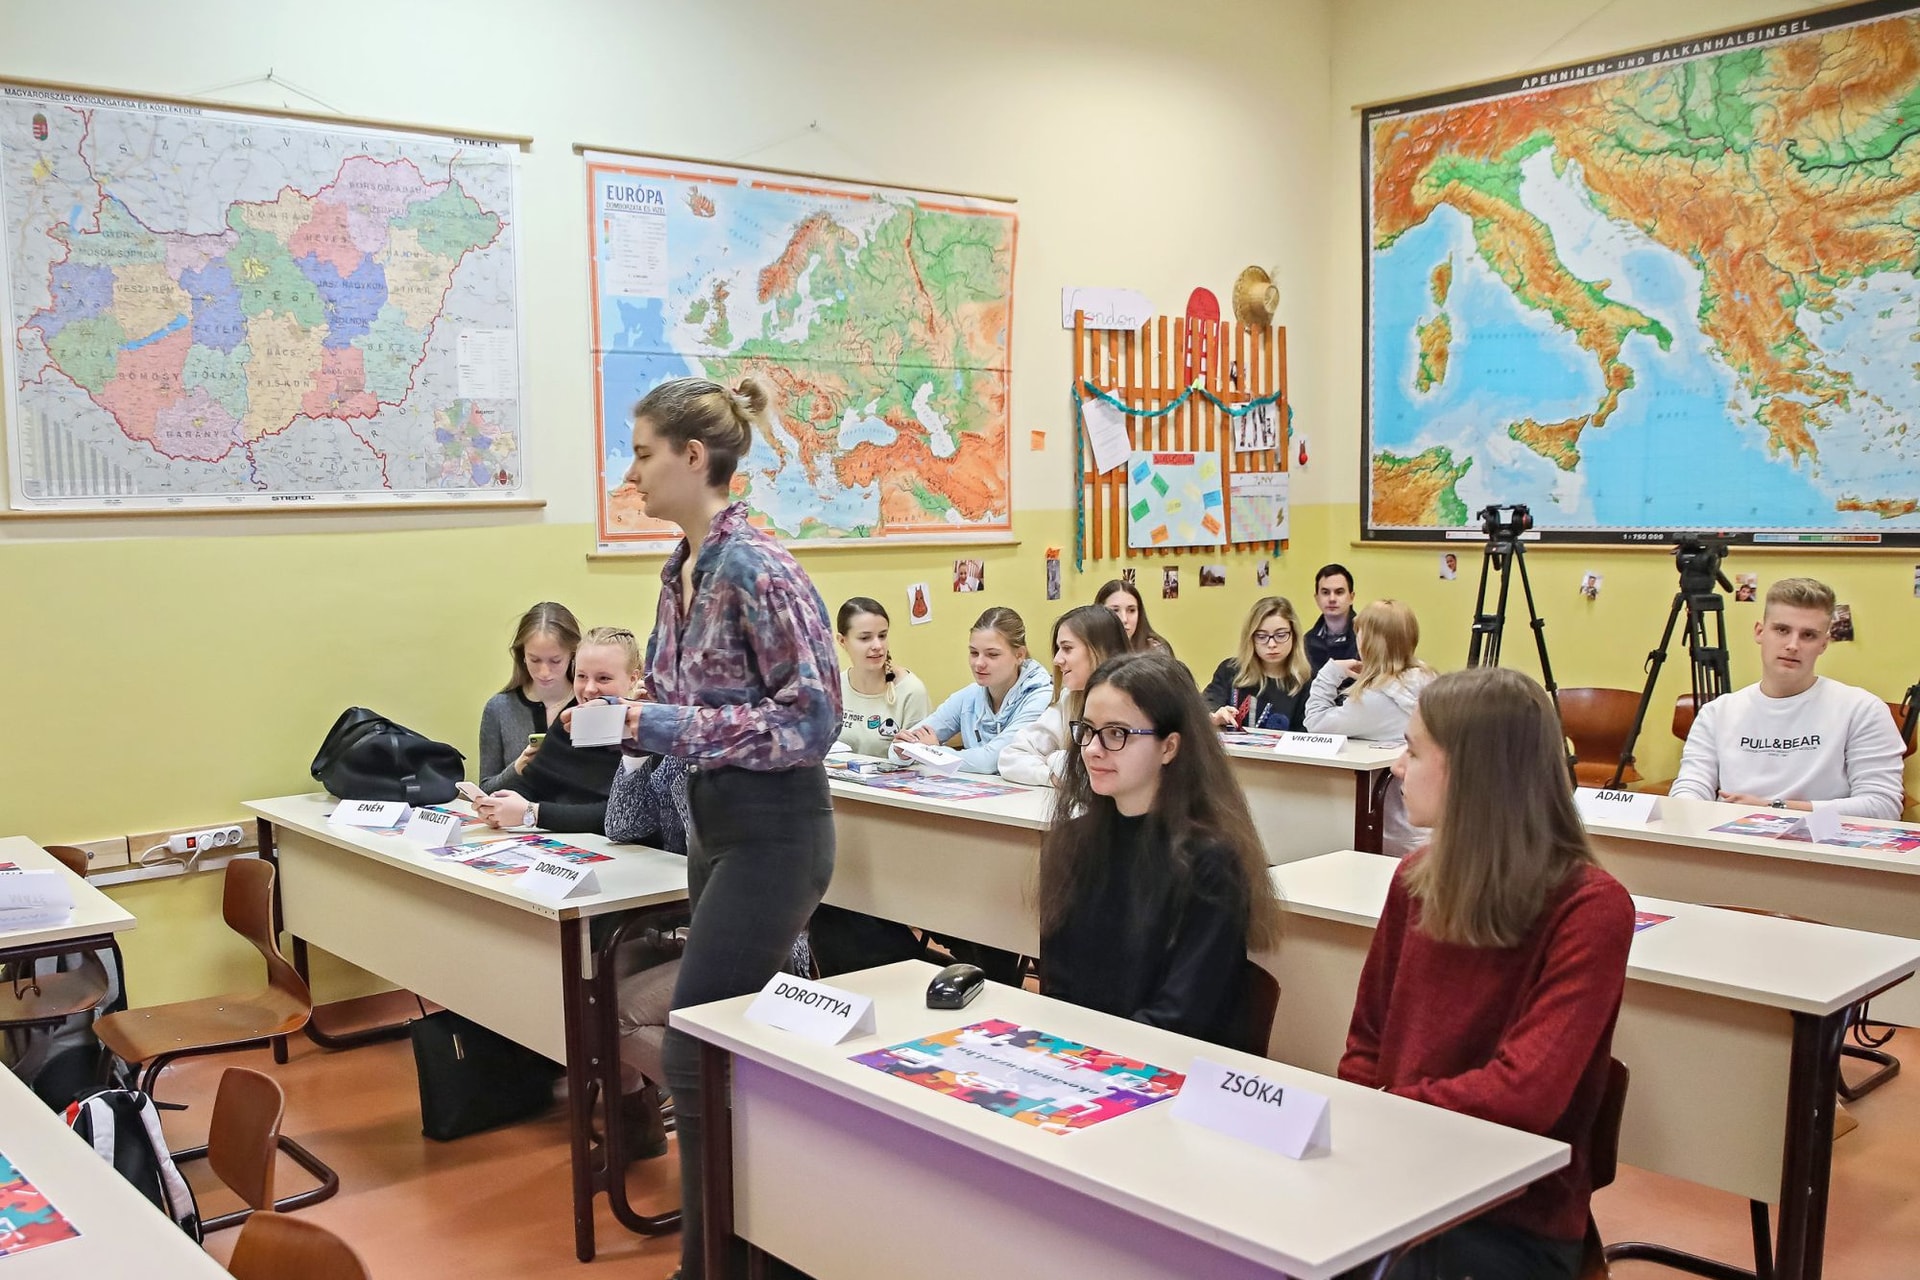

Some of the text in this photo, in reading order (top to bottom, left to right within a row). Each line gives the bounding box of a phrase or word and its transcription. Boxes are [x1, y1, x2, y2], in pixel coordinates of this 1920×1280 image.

[1521, 20, 1812, 89] APENNINEN- UND BALKANHALBINSEL
[606, 184, 664, 205] EURÓPA
[848, 714, 865, 722] MORE
[1291, 734, 1333, 744] VIKTÓRIA
[1595, 790, 1634, 803] ADAM
[357, 802, 385, 813] ENÉH
[418, 810, 451, 825] NIKOLETT
[534, 860, 580, 882] DOROTTYA
[773, 982, 852, 1019] DOROTTYA
[1220, 1071, 1285, 1107] ZSÓKA
